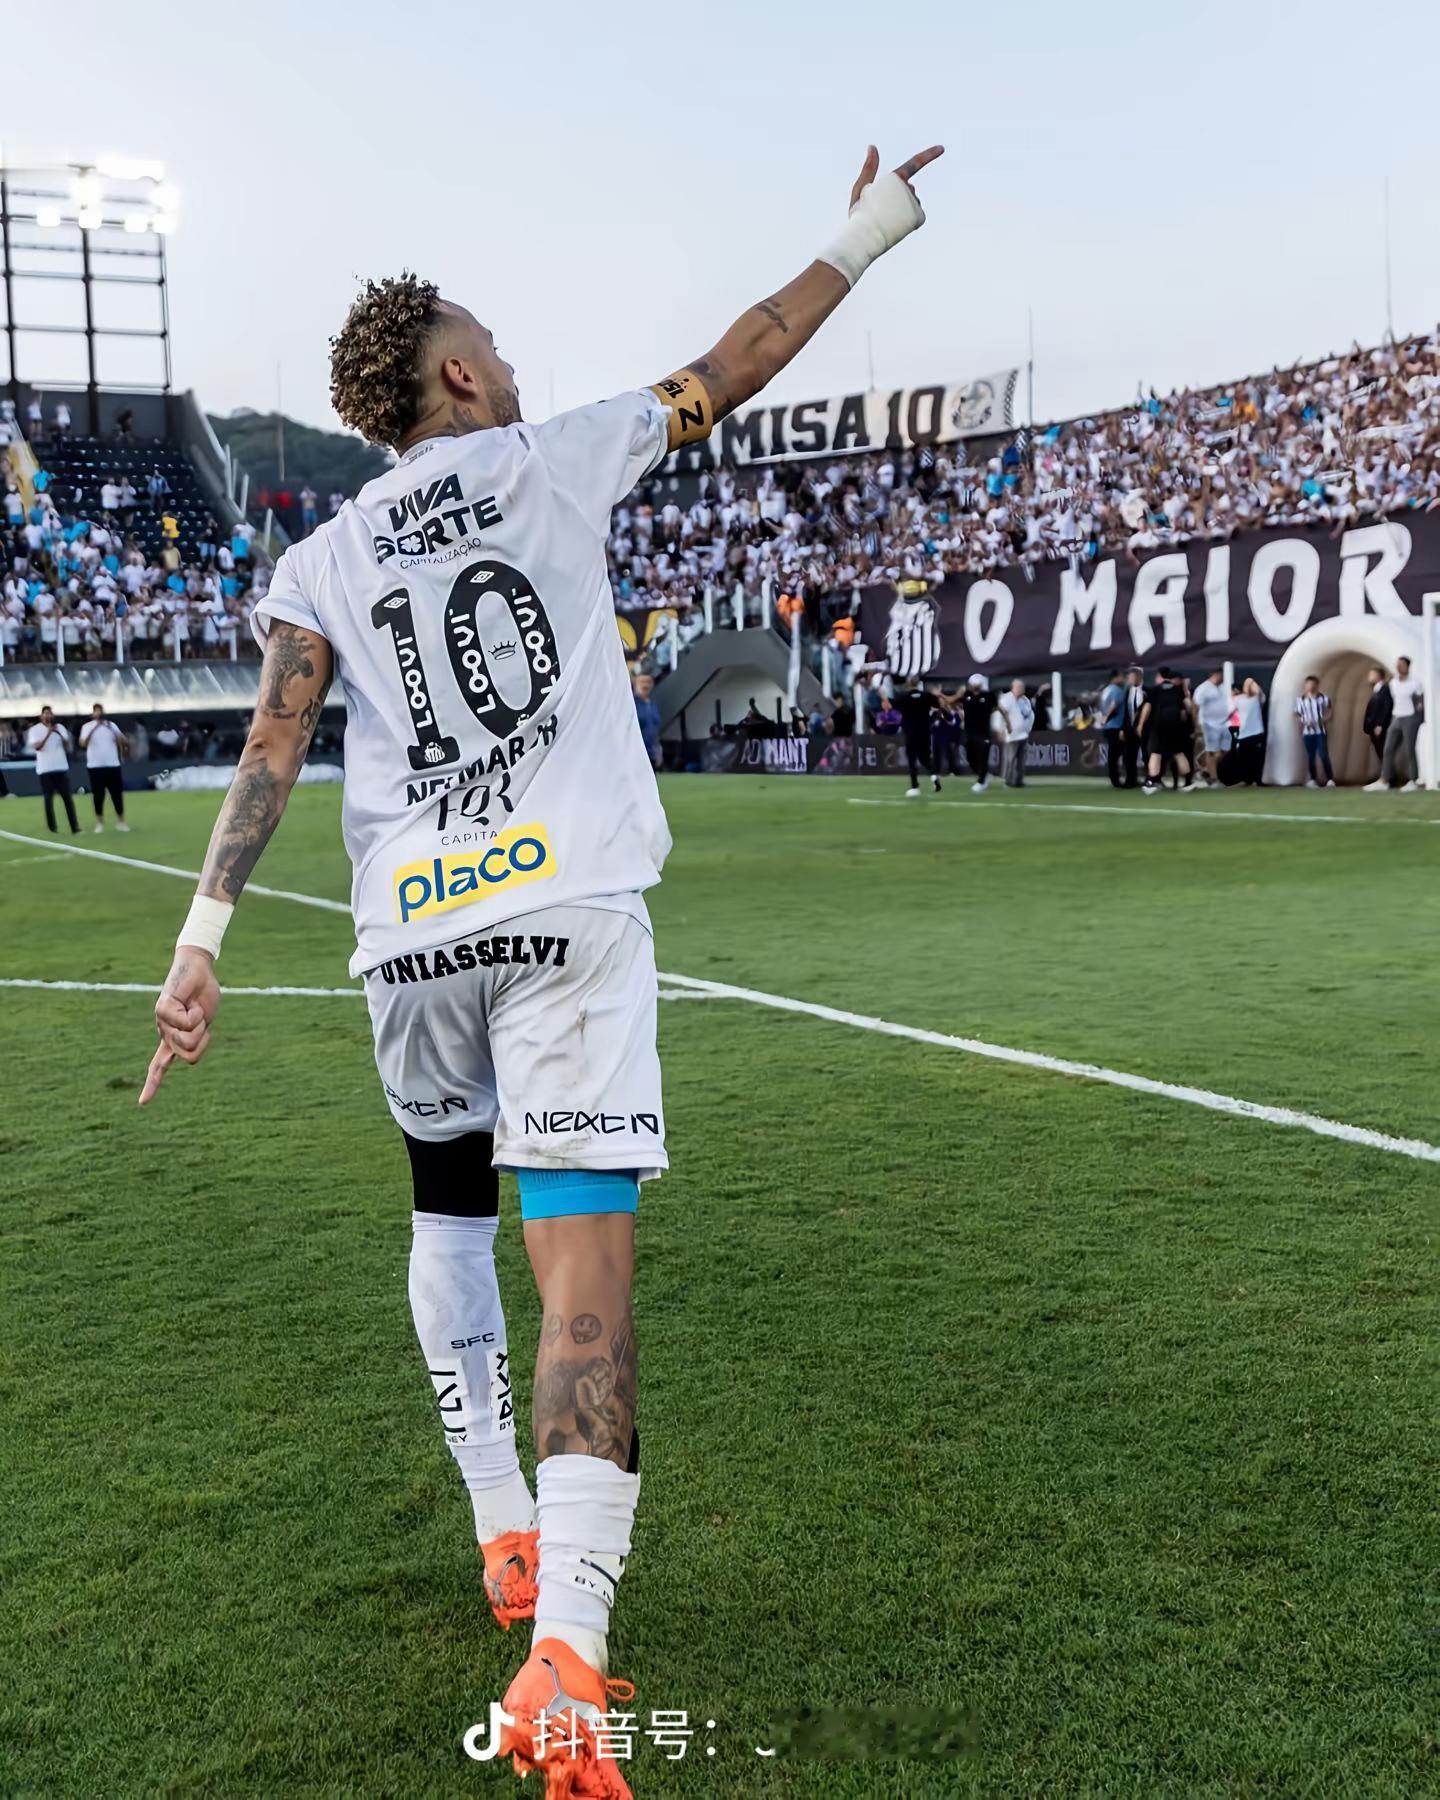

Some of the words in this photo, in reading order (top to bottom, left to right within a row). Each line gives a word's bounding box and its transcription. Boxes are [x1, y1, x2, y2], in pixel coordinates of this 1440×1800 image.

[664, 394, 869, 474] AMISA
[886, 385, 945, 445] 10
[373, 496, 503, 564] SORTE
[388, 473, 464, 532] VIVA
[964, 579, 1014, 663] O
[1049, 522, 1417, 656] MAIOR
[371, 560, 561, 771] 10
[441, 830, 498, 846] CAPITA
[398, 837, 546, 923] placo
[380, 935, 570, 985] UNIASSELVI
[450, 1332, 495, 1349] SFC
